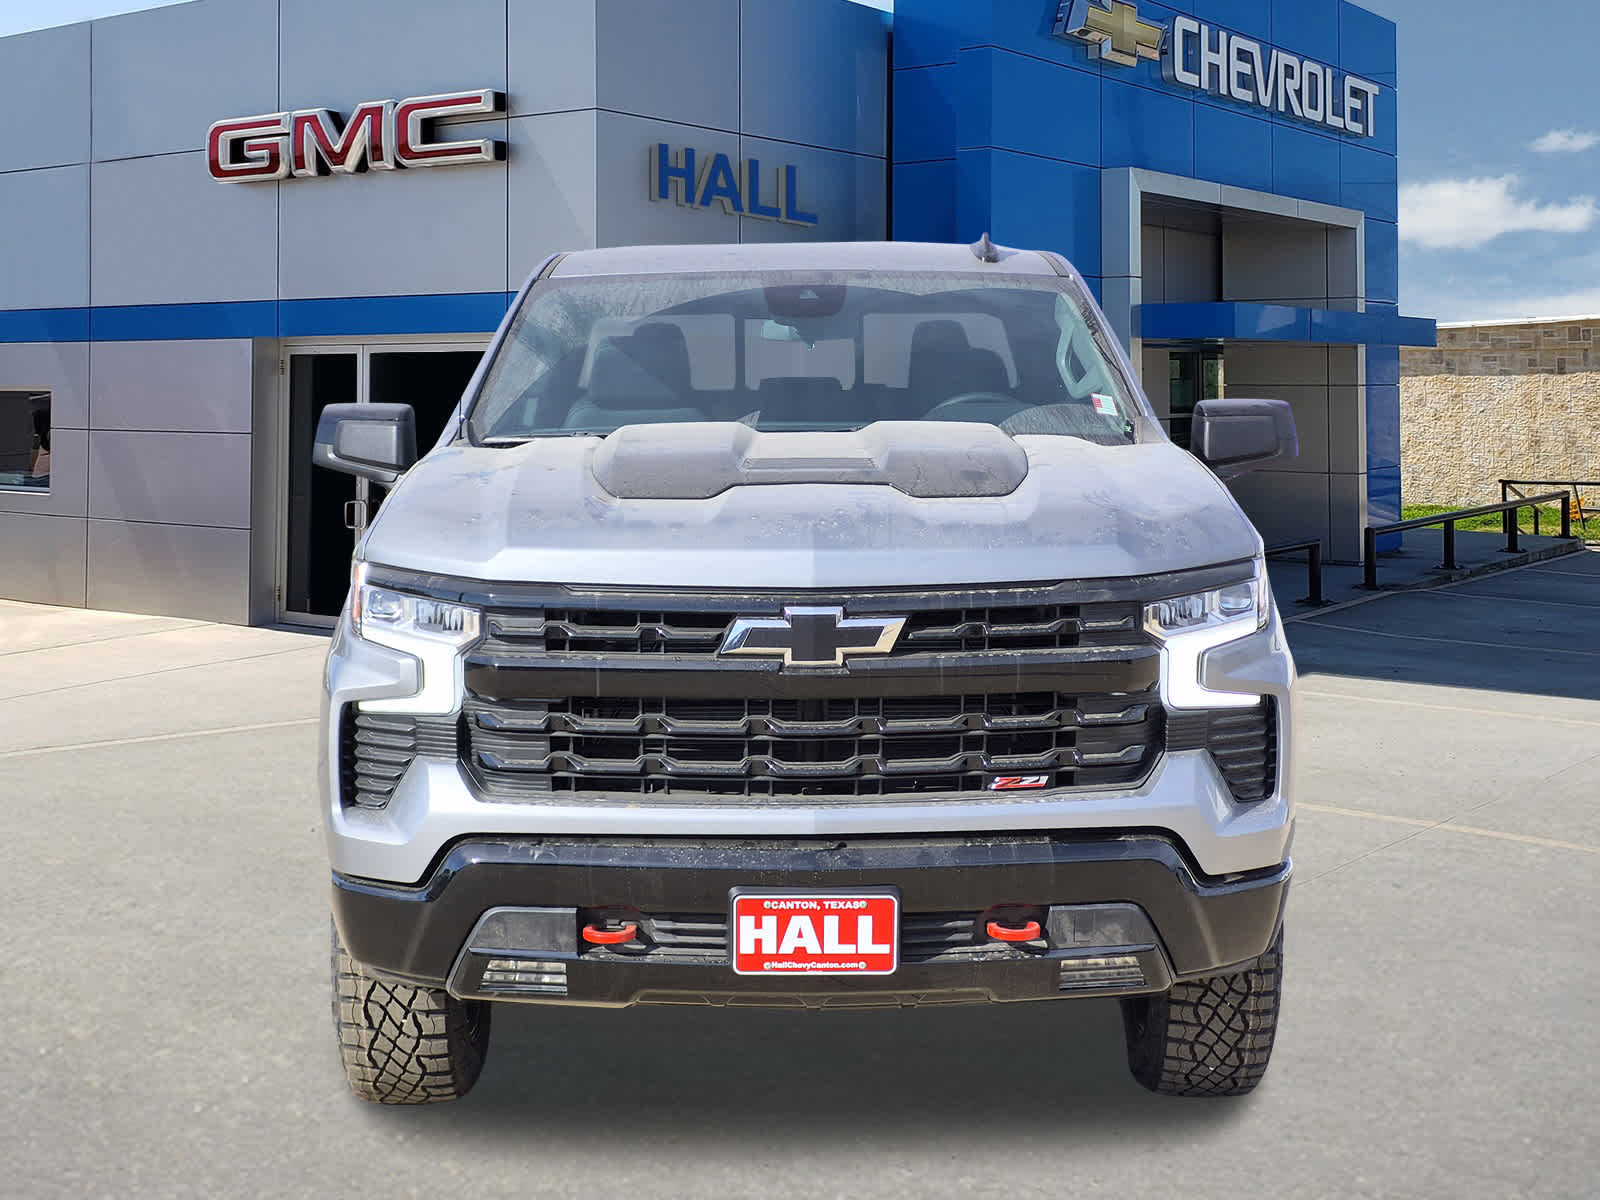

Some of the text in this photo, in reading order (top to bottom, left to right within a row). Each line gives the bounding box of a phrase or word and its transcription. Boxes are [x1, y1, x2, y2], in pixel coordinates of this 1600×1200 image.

[1172, 15, 1379, 137] CHEVROLET
[206, 88, 507, 184] GMC
[650, 142, 819, 226] HALL
[739, 915, 890, 954] HALL
[772, 901, 860, 911] CANTON, TEXAS
[771, 961, 858, 970] HallChevyCanton.com
